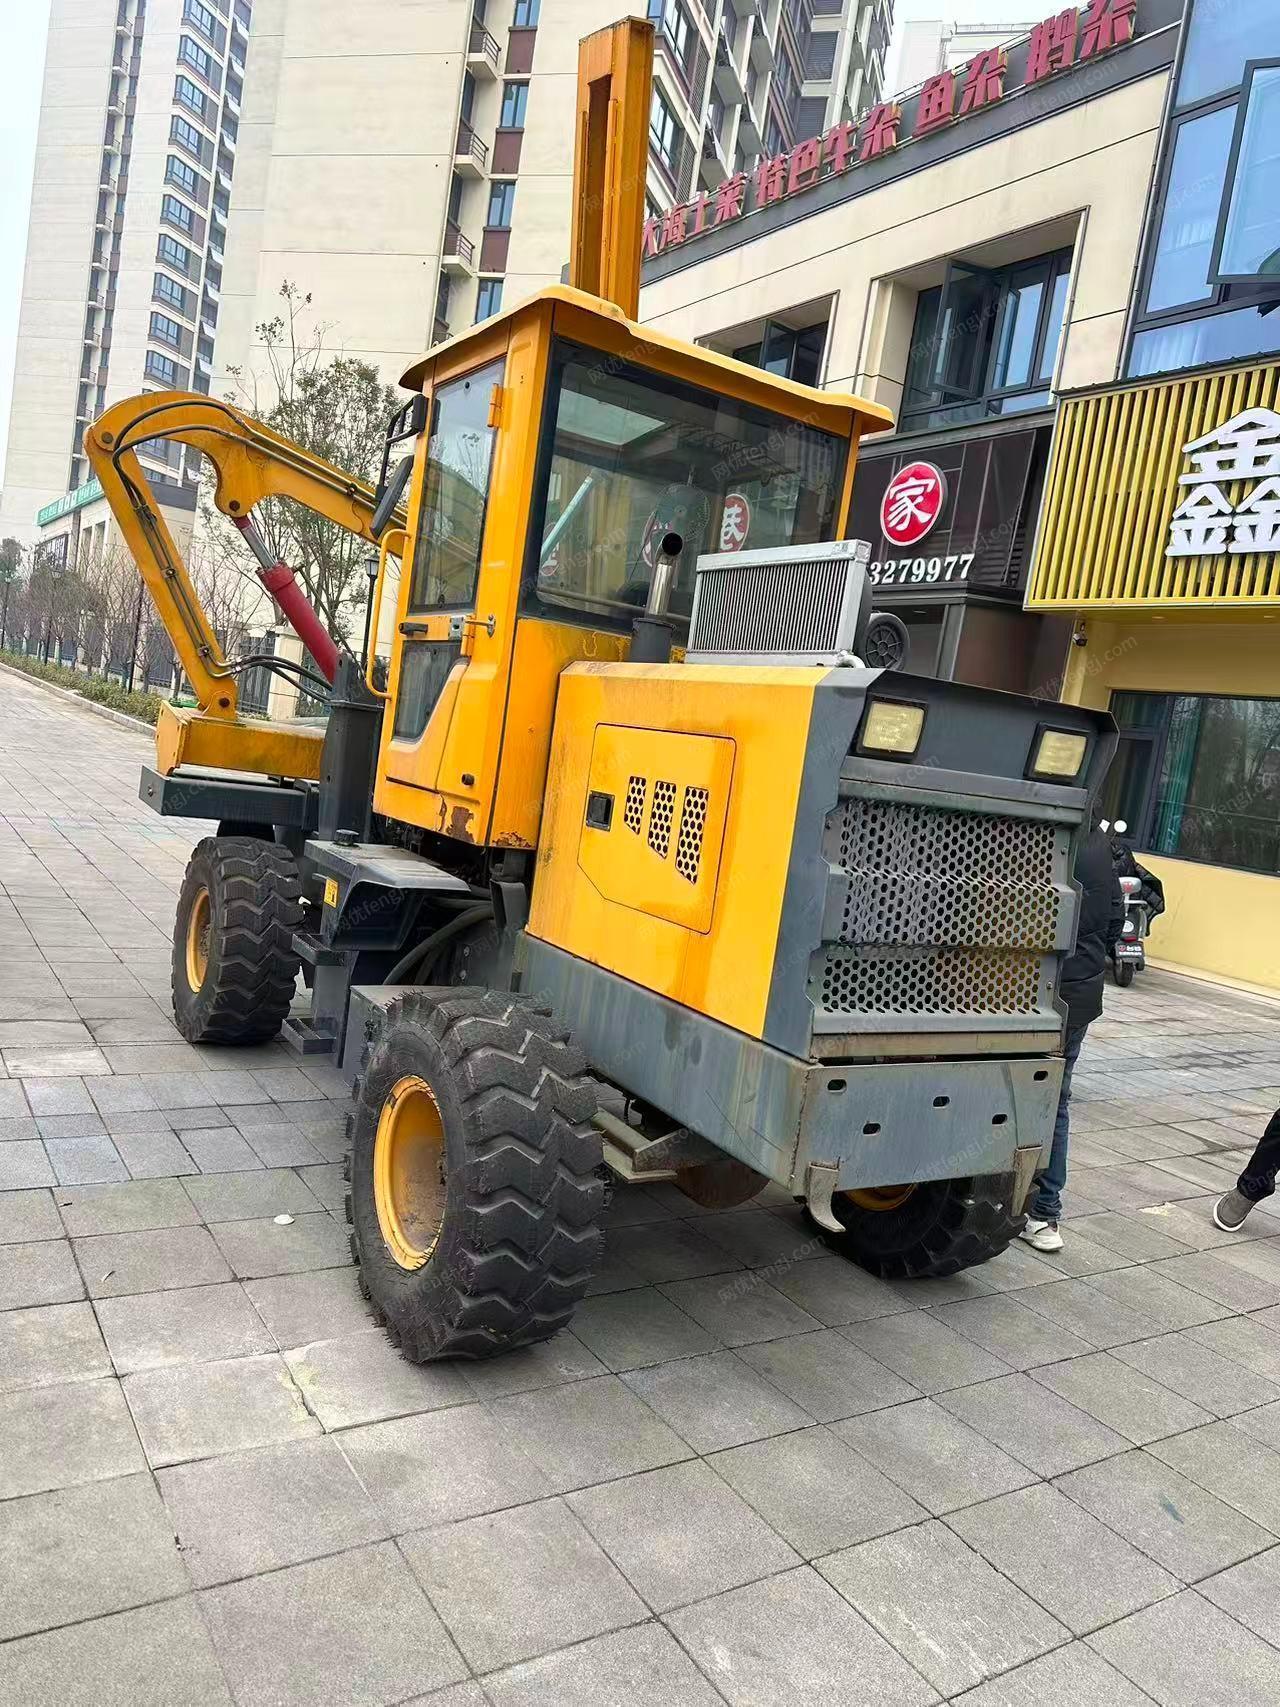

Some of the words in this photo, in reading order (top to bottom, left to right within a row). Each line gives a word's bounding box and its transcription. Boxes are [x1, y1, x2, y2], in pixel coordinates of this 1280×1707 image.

[886, 476, 936, 531] 家
[1165, 406, 1280, 557] 鑫
[869, 552, 976, 586] 3279977
